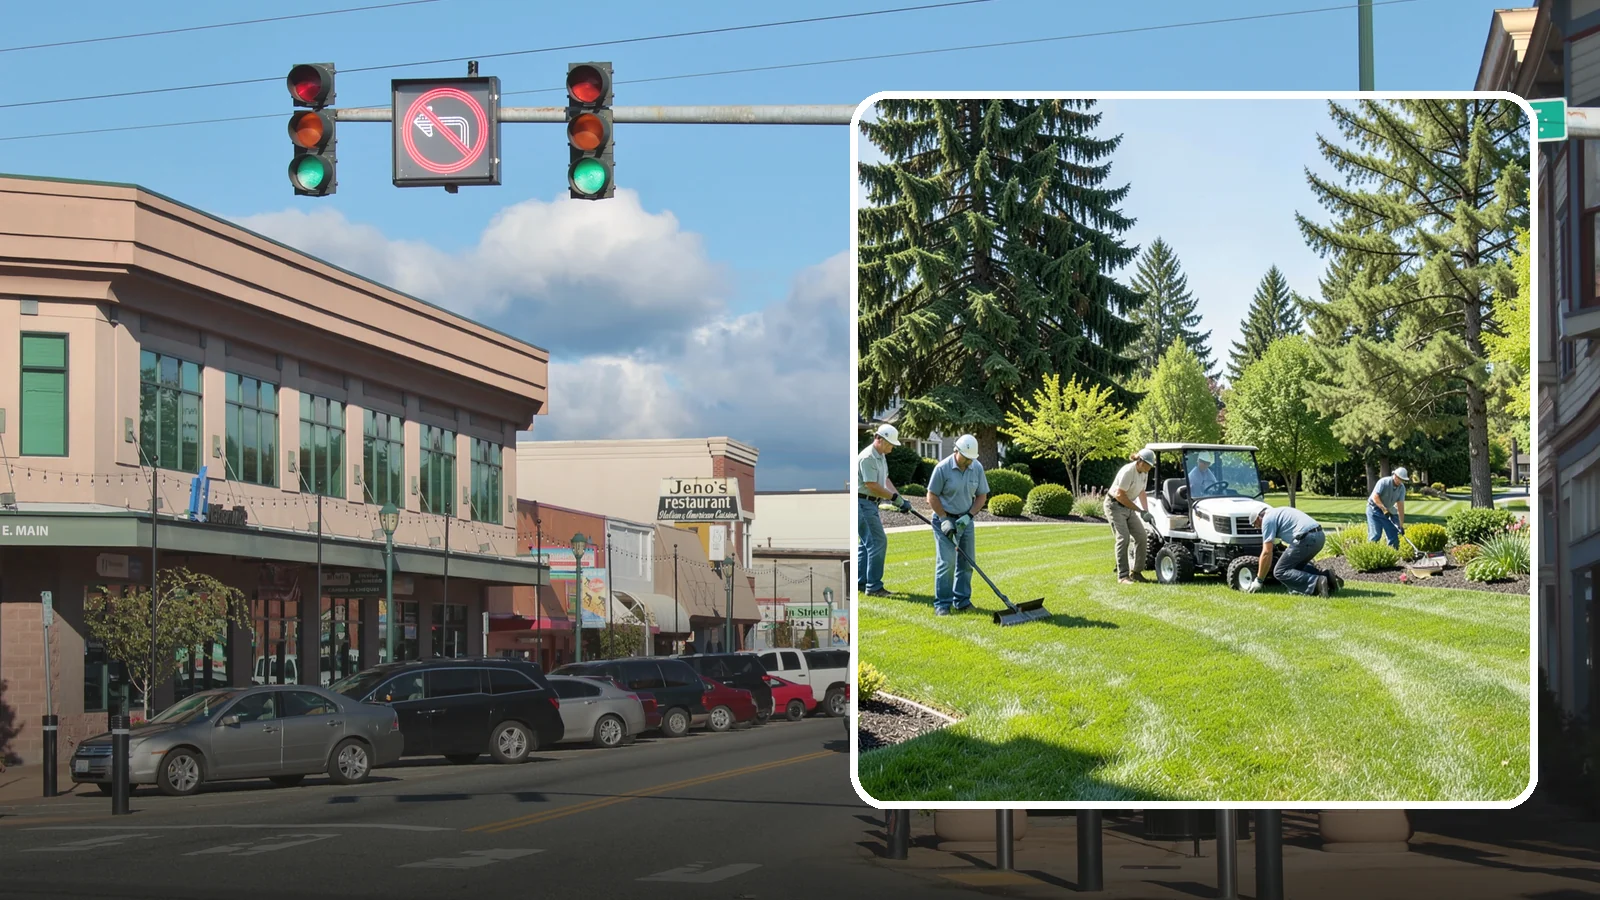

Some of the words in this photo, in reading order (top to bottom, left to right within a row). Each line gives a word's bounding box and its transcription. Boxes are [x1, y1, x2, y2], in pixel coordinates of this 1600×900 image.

[670, 480, 727, 494] Jeno's
[665, 497, 731, 509] restaurant
[658, 509, 682, 520] Italian
[686, 510, 714, 519] American
[715, 509, 737, 519] Cuisine
[2, 525, 13, 536] E.
[15, 525, 49, 536] MAIN
[797, 608, 828, 617] Street
